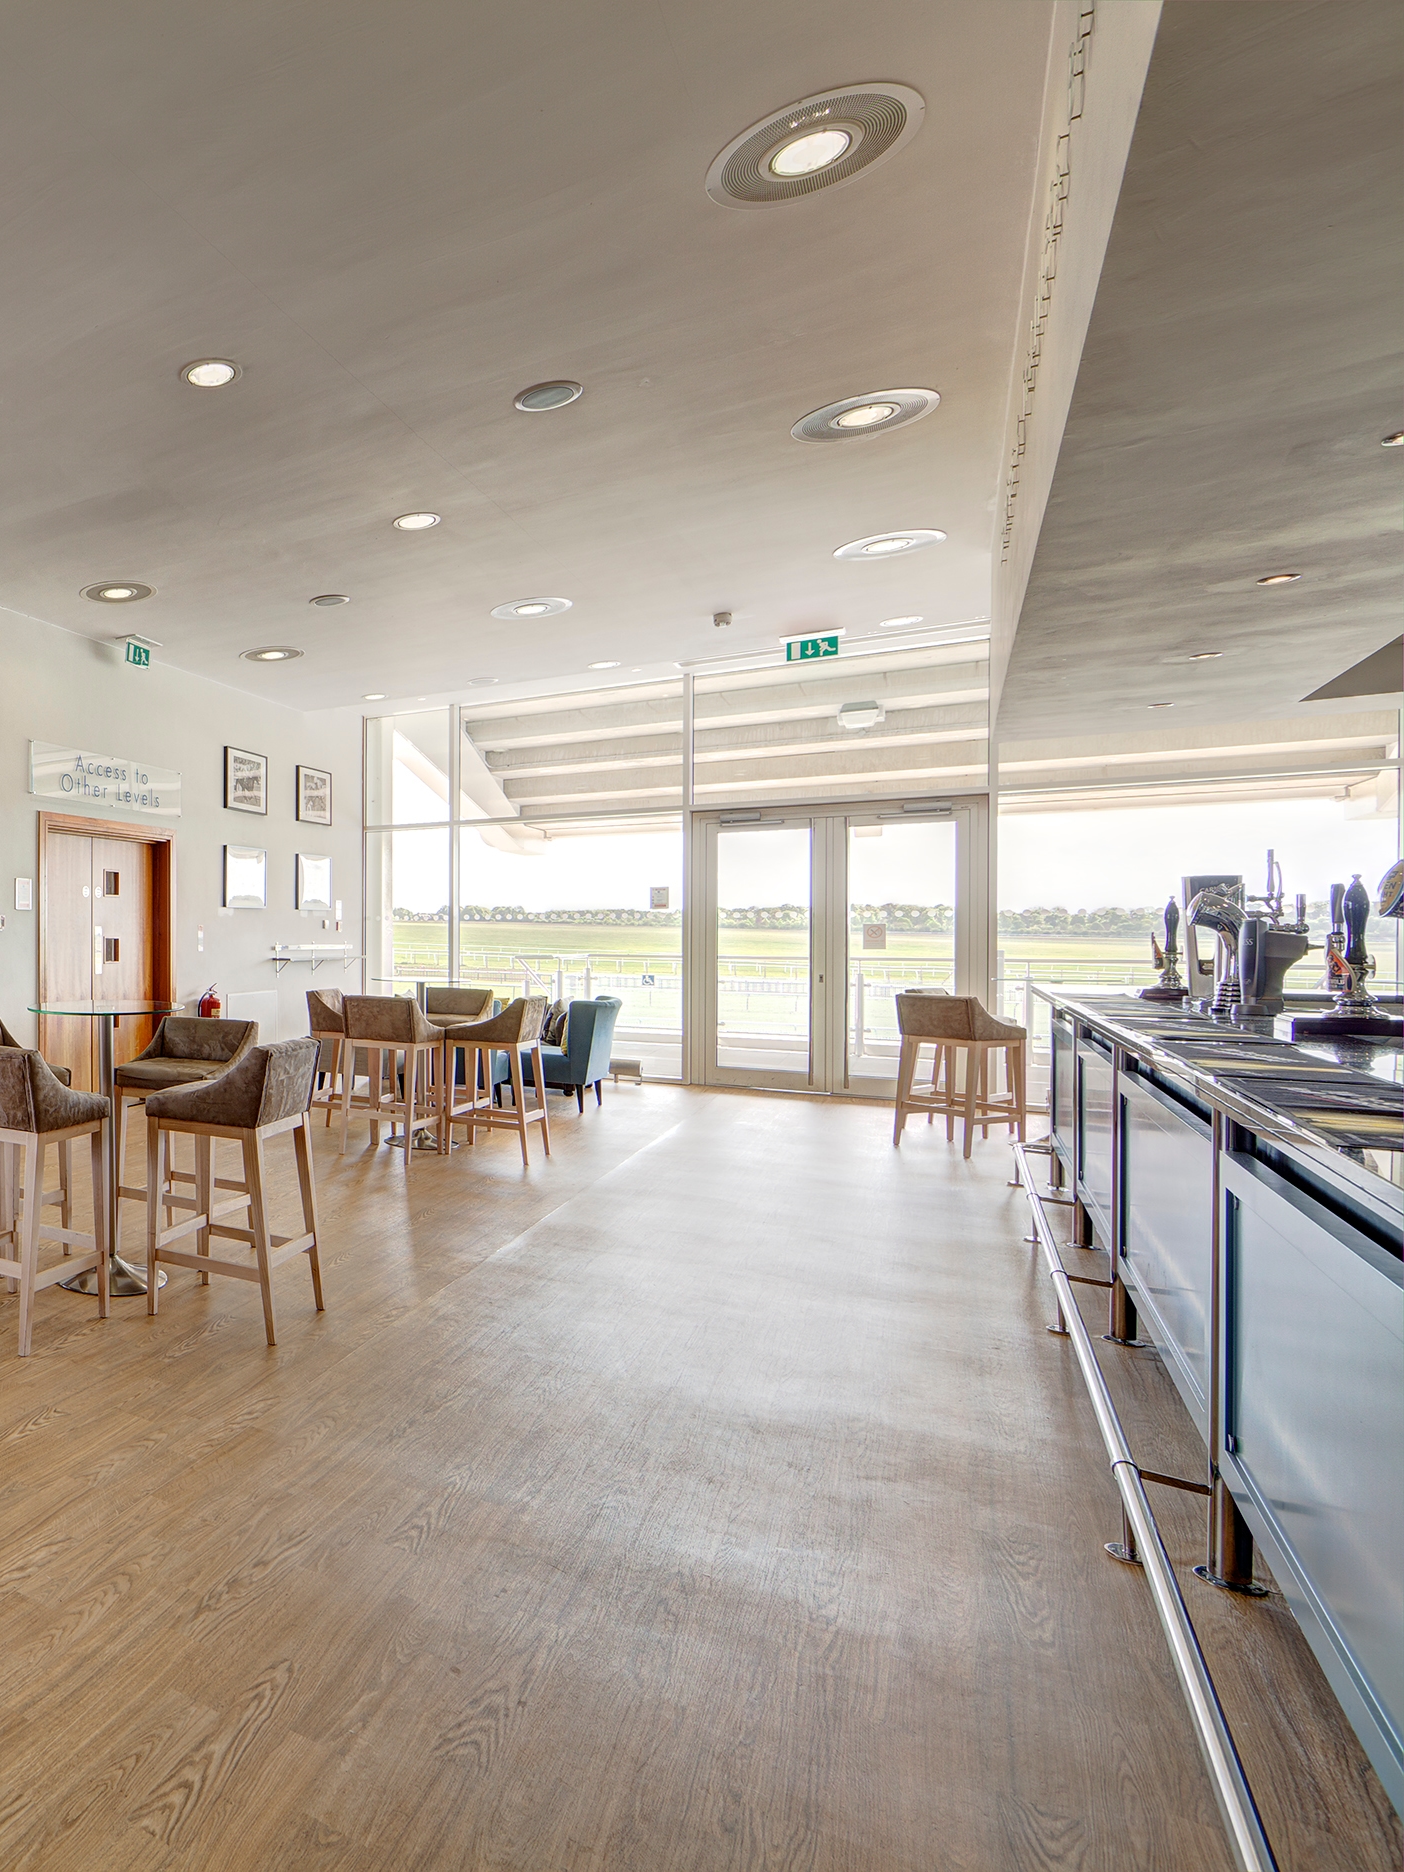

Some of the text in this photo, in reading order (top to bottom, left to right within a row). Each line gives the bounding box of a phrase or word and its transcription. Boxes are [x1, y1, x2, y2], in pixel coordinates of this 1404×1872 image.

[75, 755, 149, 785] Access to
[61, 773, 160, 807] Other Levels
